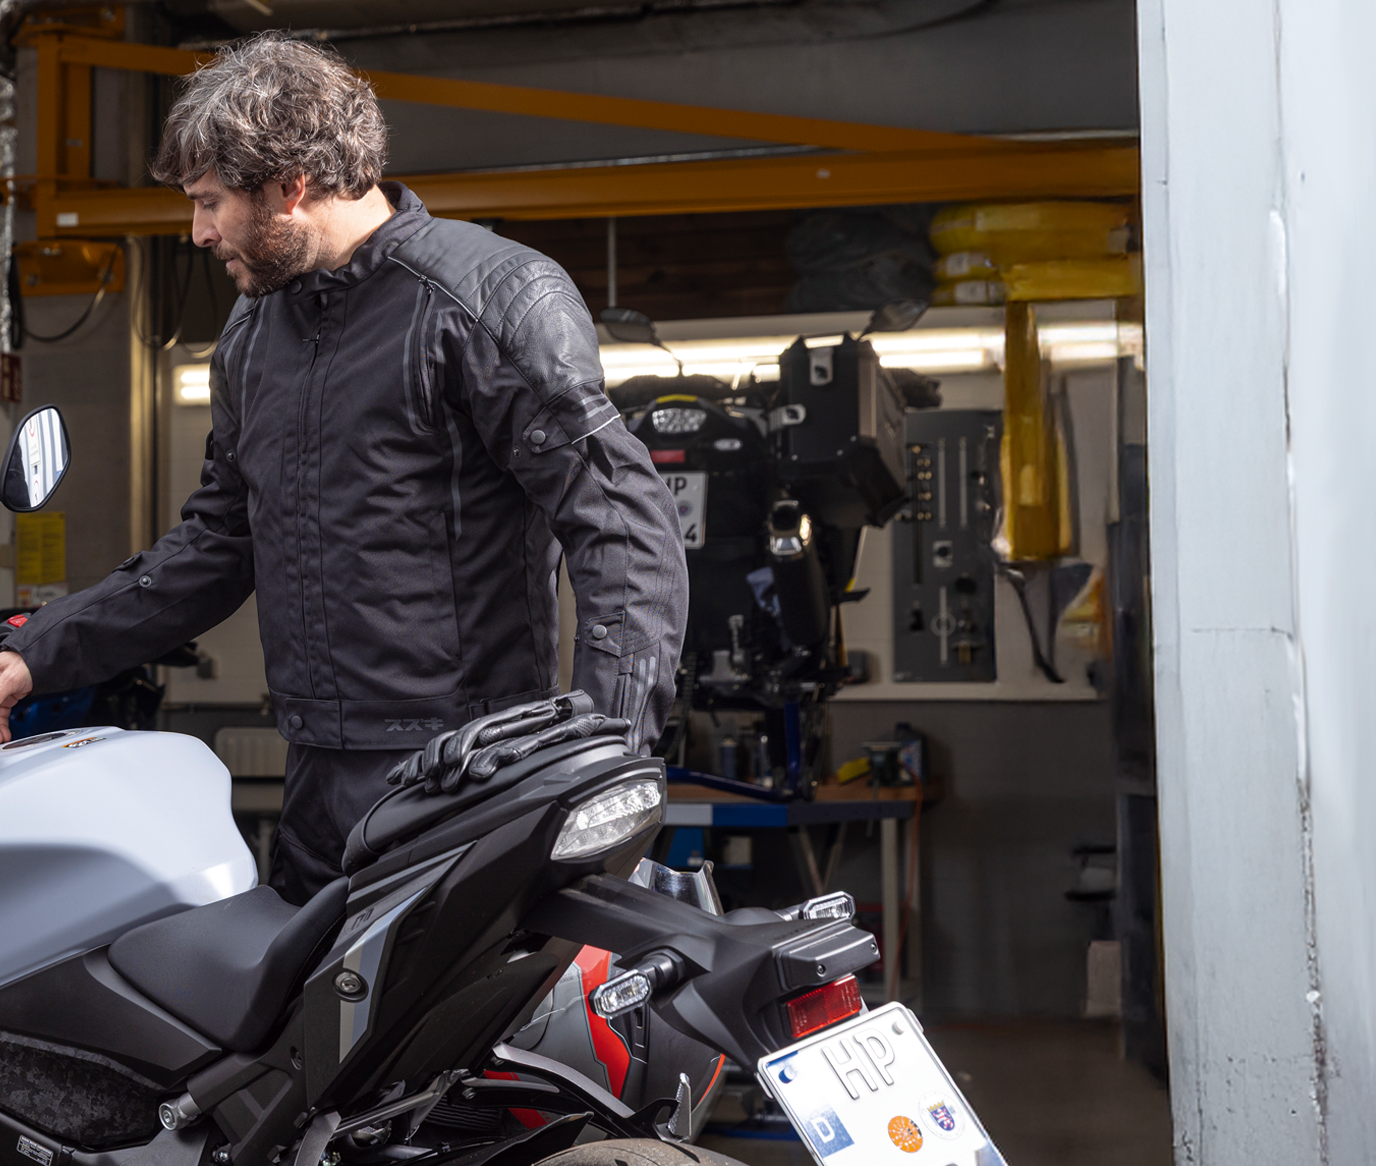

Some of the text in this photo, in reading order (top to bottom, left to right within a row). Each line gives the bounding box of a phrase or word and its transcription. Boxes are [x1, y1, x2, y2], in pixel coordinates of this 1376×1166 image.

[384, 717, 444, 731] スズキ
[821, 1029, 896, 1101] HP
[811, 1116, 836, 1144] D
